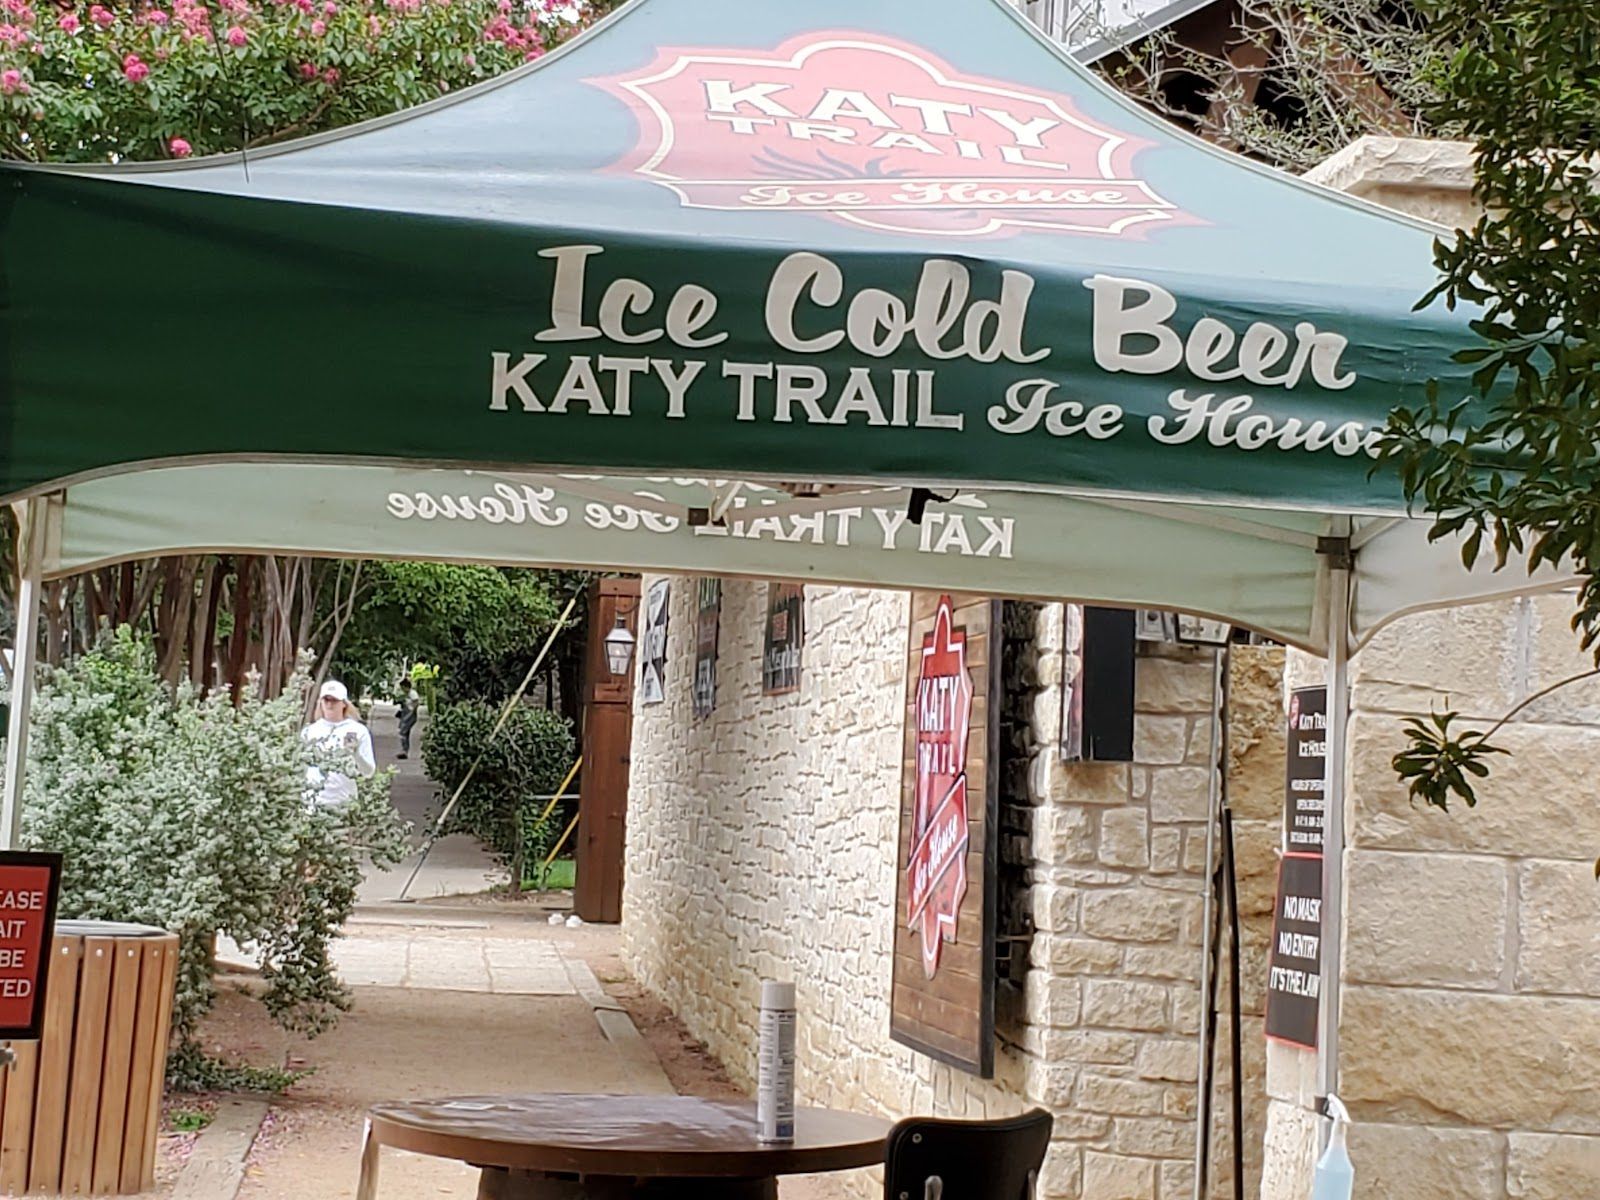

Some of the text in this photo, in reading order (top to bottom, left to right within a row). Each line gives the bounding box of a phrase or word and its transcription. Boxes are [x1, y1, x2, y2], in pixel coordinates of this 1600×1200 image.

[703, 79, 1062, 149] KATY
[706, 114, 1068, 172] TRAIL
[739, 182, 1128, 206] Ice House
[534, 245, 1357, 390] Ice Cold Beer
[489, 352, 707, 418] KATY
[722, 360, 964, 431] TRAIL
[987, 378, 1124, 439] Ice
[919, 677, 960, 732] KATY
[1284, 896, 1321, 922] NO MASK
[1279, 931, 1319, 959] NO ENTRY
